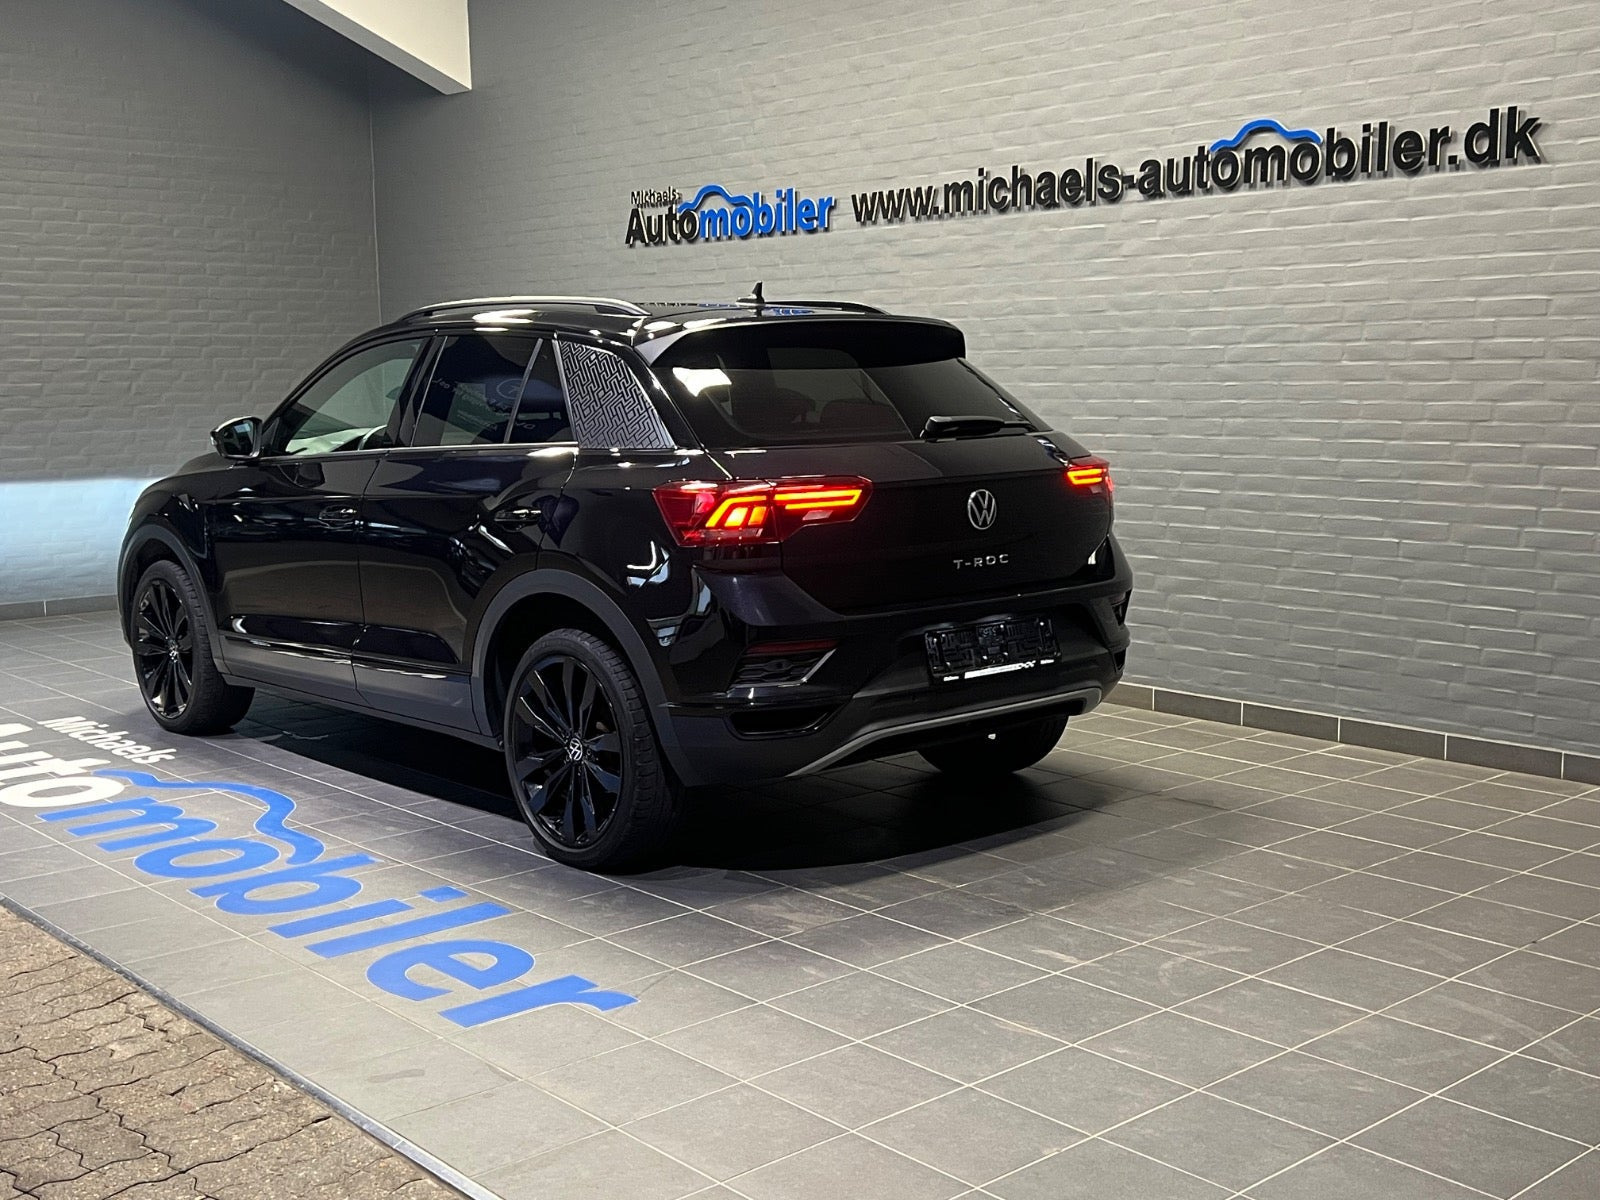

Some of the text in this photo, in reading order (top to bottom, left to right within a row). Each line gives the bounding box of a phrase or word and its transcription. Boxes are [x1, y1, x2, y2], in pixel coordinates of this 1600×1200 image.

[851, 105, 1542, 223] www.michaels-automobiler.dk
[625, 187, 834, 245] Automobiler
[630, 186, 679, 206] Michaels
[953, 553, 1009, 570] T-ROC
[38, 716, 177, 763] Michaels
